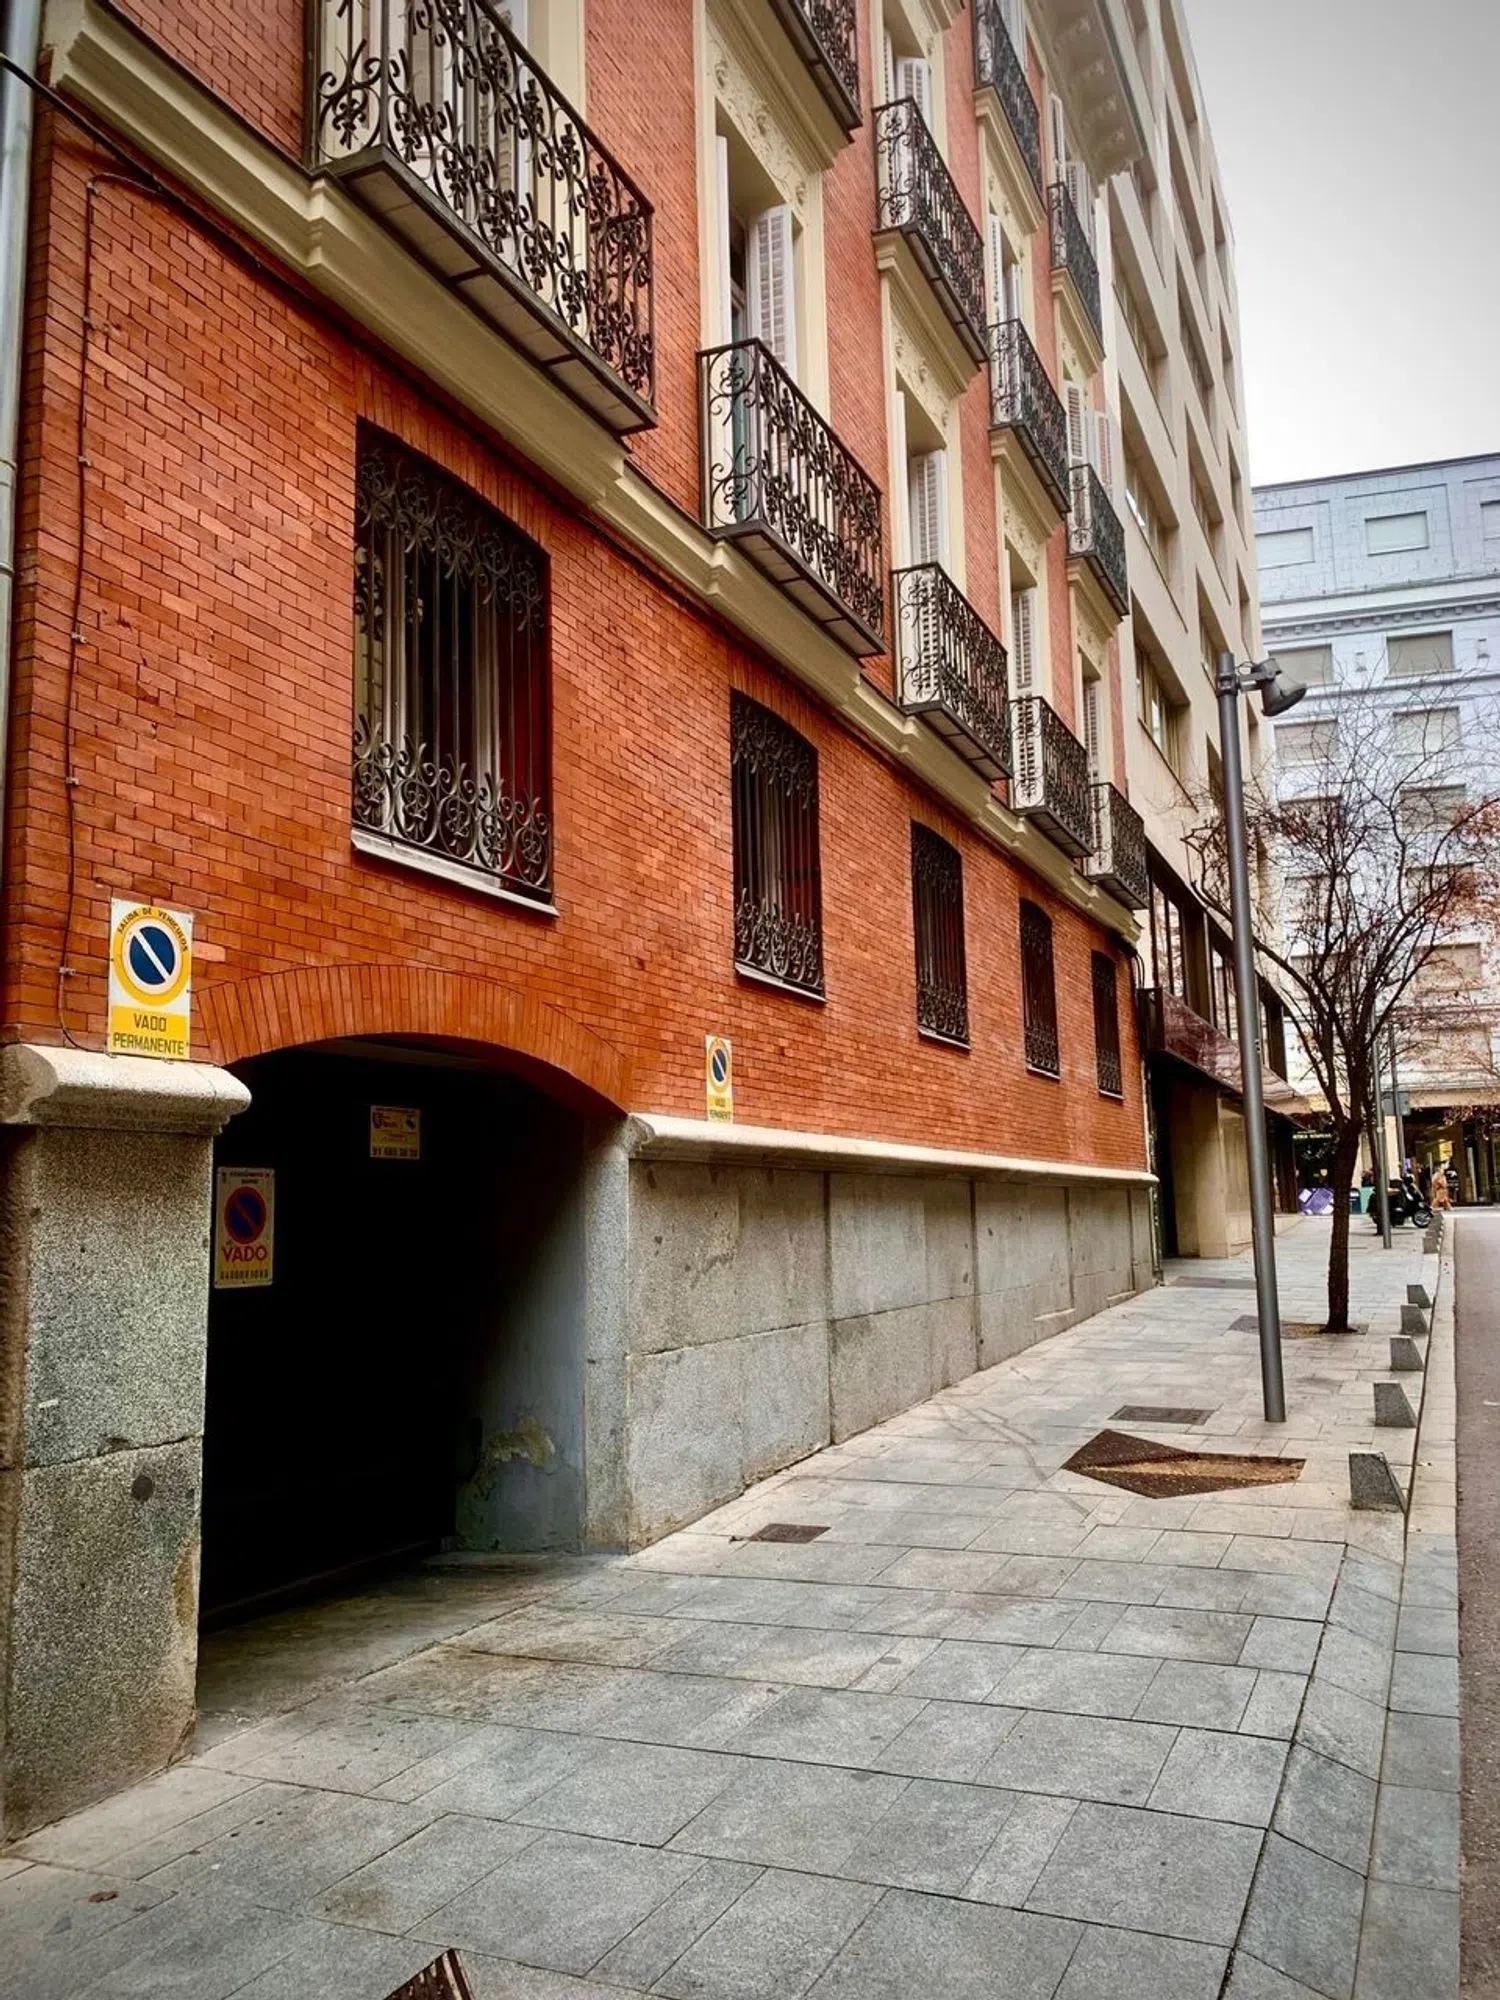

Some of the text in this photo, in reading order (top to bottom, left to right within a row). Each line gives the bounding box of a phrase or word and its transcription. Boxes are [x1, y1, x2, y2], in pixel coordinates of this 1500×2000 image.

[117, 907, 189, 952] SALIDA DE VEHICULOS
[133, 1013, 167, 1032] VADO
[113, 1032, 184, 1055] PERMANENTE
[222, 1245, 268, 1263] VADO
